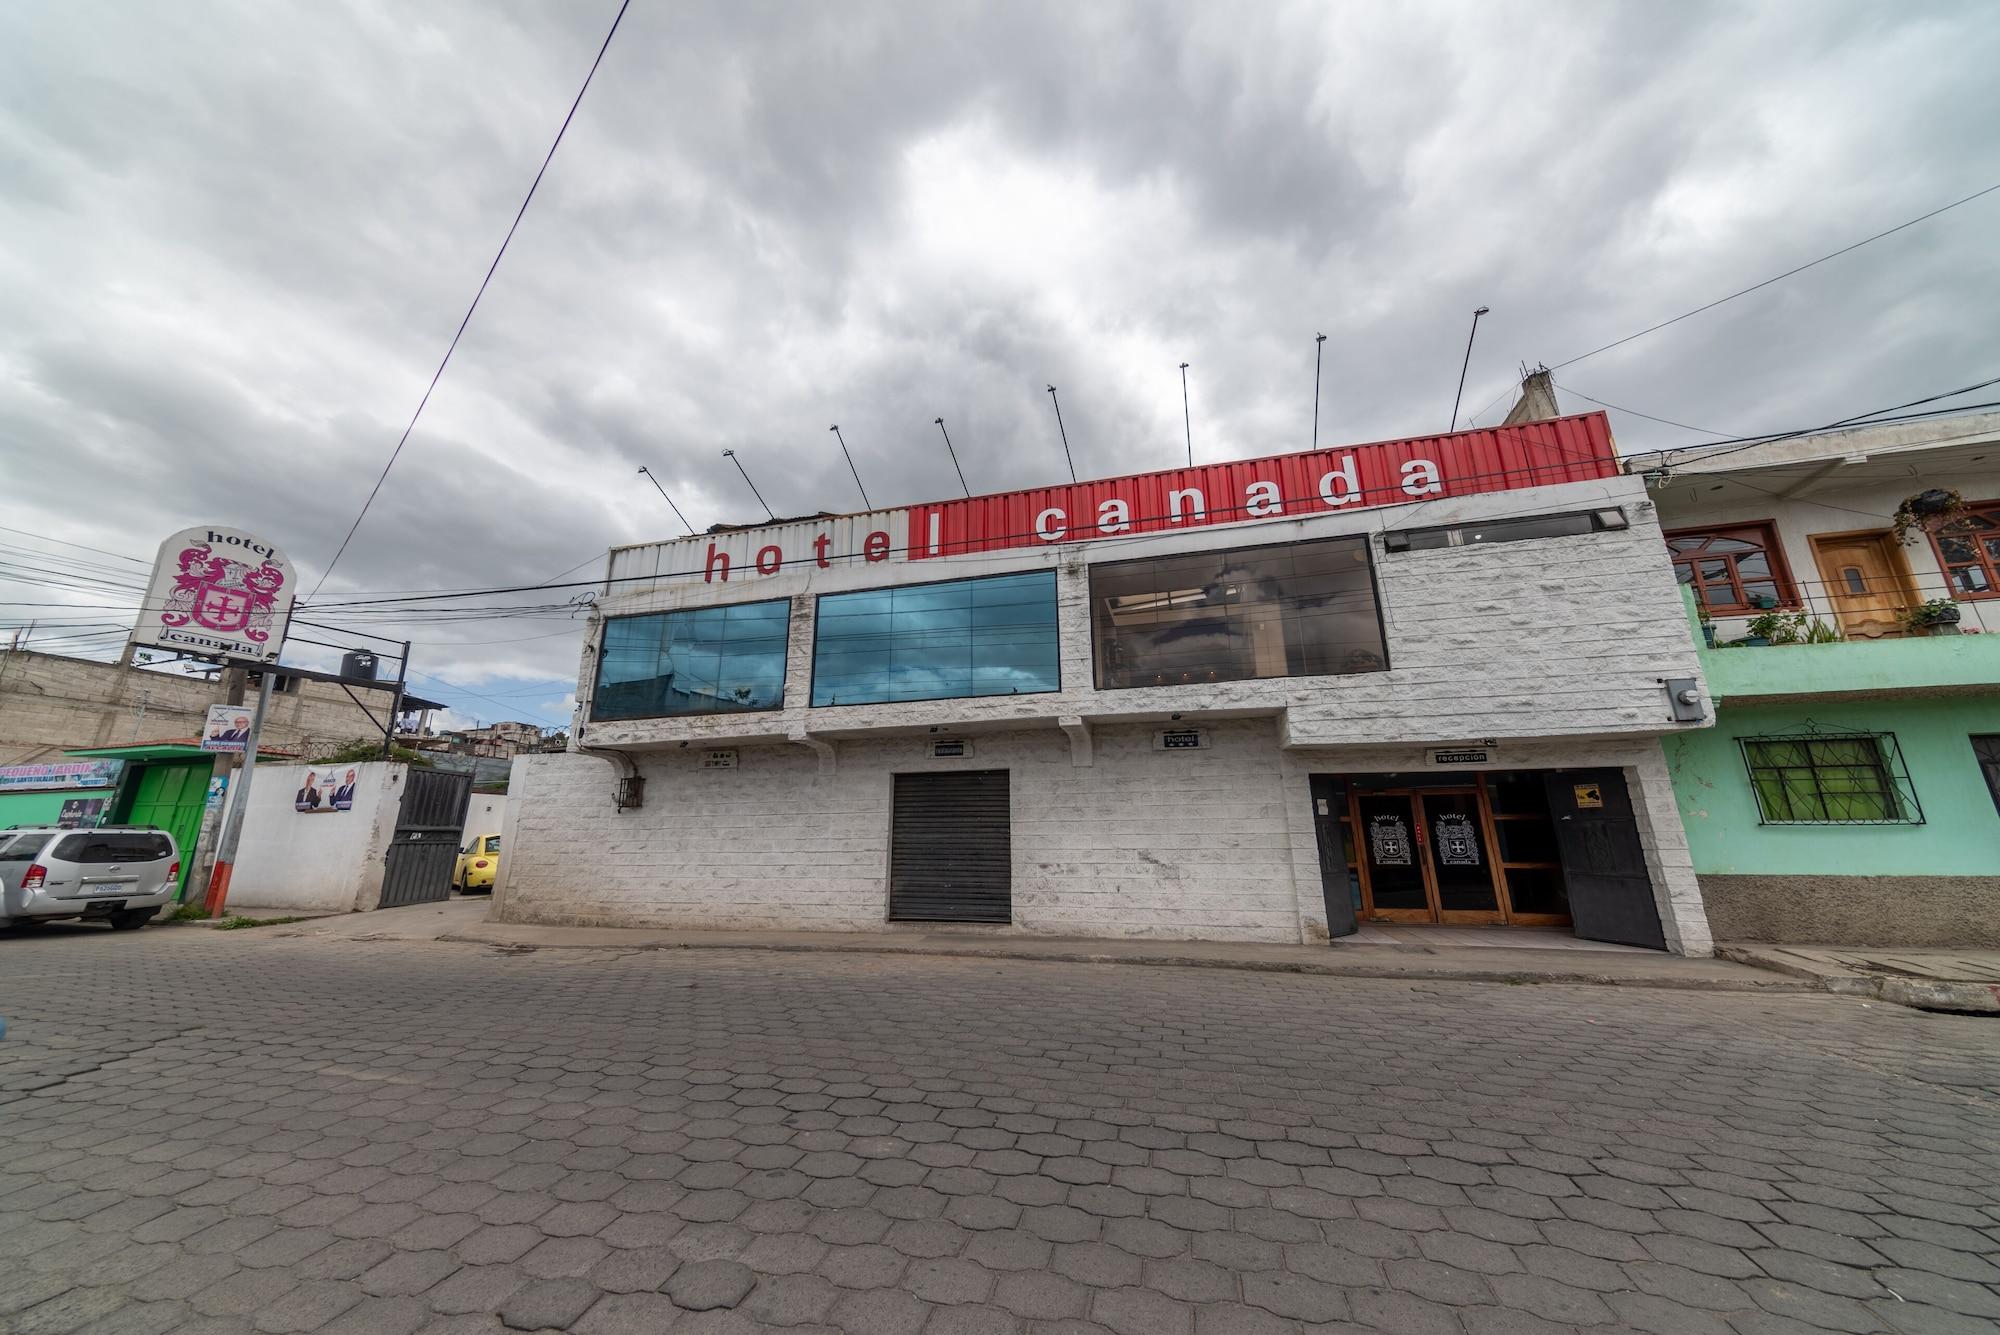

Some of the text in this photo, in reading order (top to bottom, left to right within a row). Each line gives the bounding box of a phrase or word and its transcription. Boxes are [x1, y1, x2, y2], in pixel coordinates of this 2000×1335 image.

[704, 456, 1442, 584] hotel canada
[207, 531, 275, 559] hotel
[1167, 735, 1195, 743] hotel
[1374, 814, 1400, 822] hotel
[1439, 813, 1466, 821] hotel
